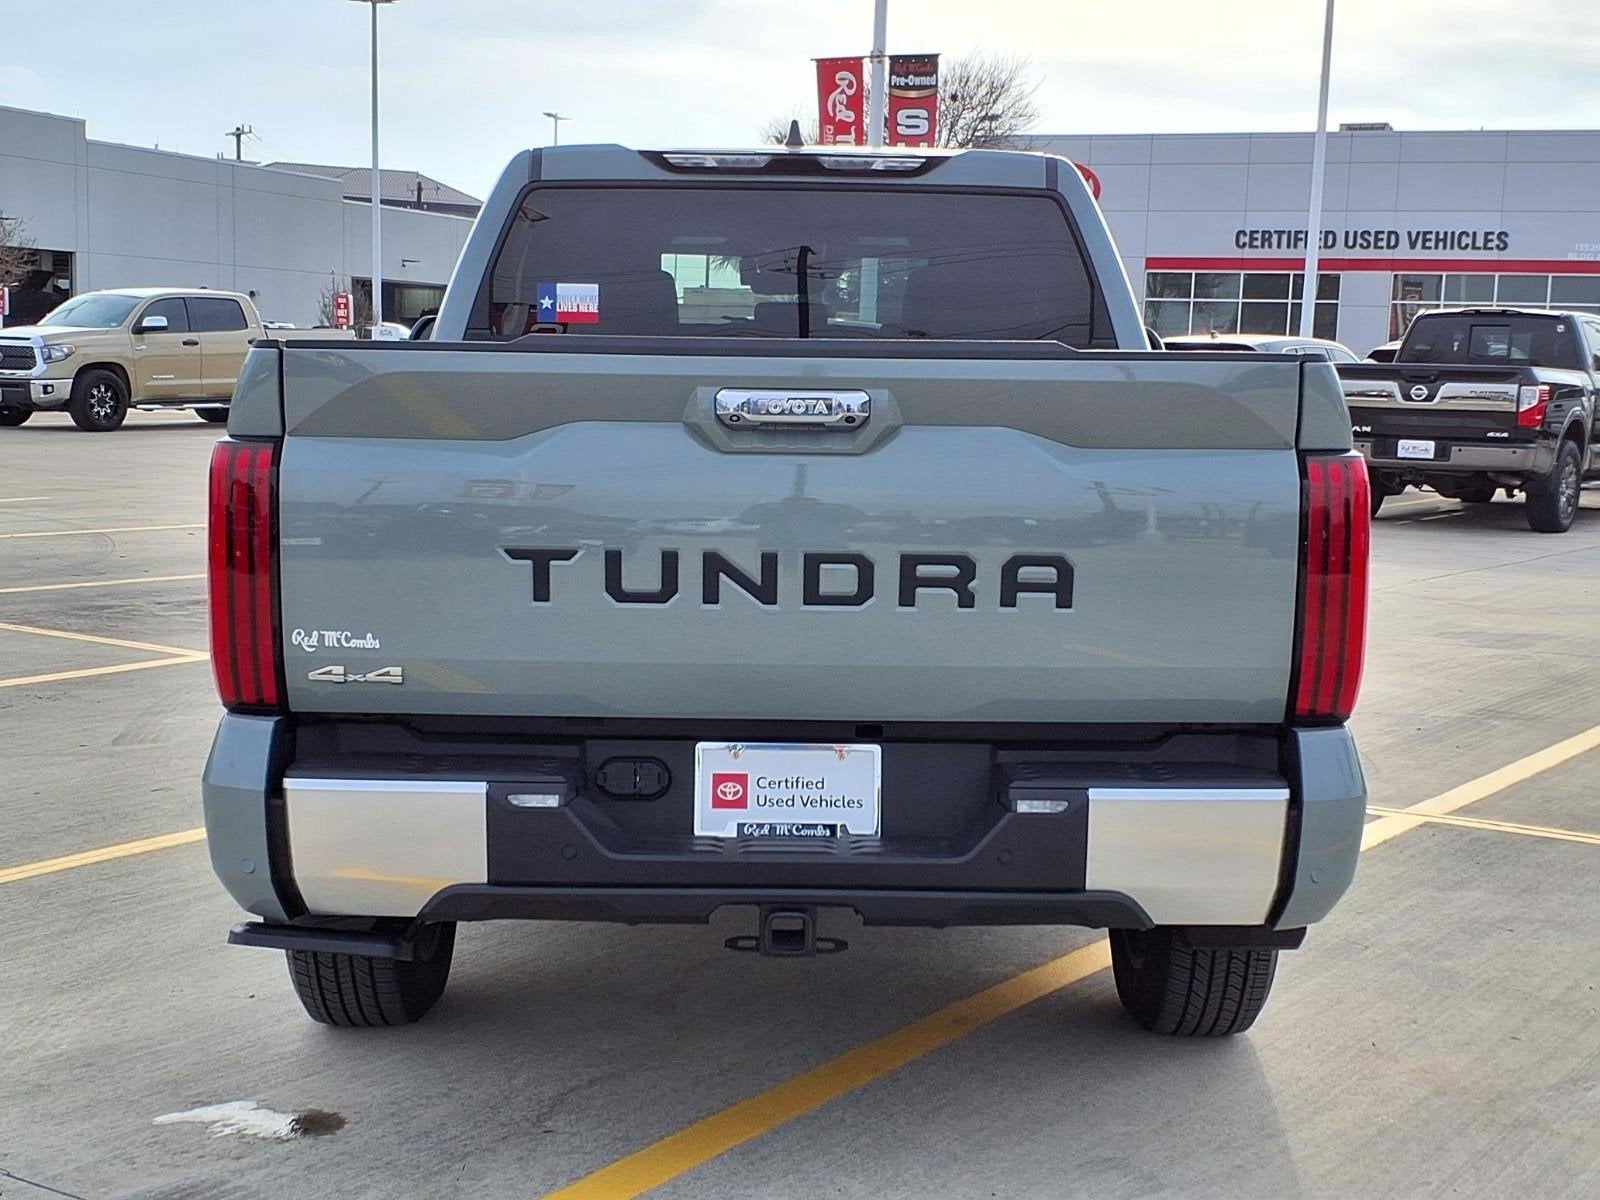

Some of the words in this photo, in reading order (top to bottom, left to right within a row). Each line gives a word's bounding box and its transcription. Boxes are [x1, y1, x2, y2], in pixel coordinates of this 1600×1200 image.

[891, 74, 936, 86] Pre-Owned
[827, 71, 857, 122] Red
[1234, 229, 1336, 249] CERTIFID
[1344, 230, 1400, 250] USED
[1407, 230, 1509, 251] VEHICLES
[557, 303, 577, 312] LIVES
[579, 303, 598, 312] HERE
[758, 399, 829, 414] TOYOTA
[499, 547, 1076, 613] TUNDRA
[291, 628, 319, 652] Red
[320, 630, 381, 649] McCombs
[756, 776, 825, 790] Certified
[756, 795, 795, 808] Used
[800, 795, 864, 809] Vehicles
[743, 823, 770, 837] Red
[774, 823, 831, 837] McCombs
